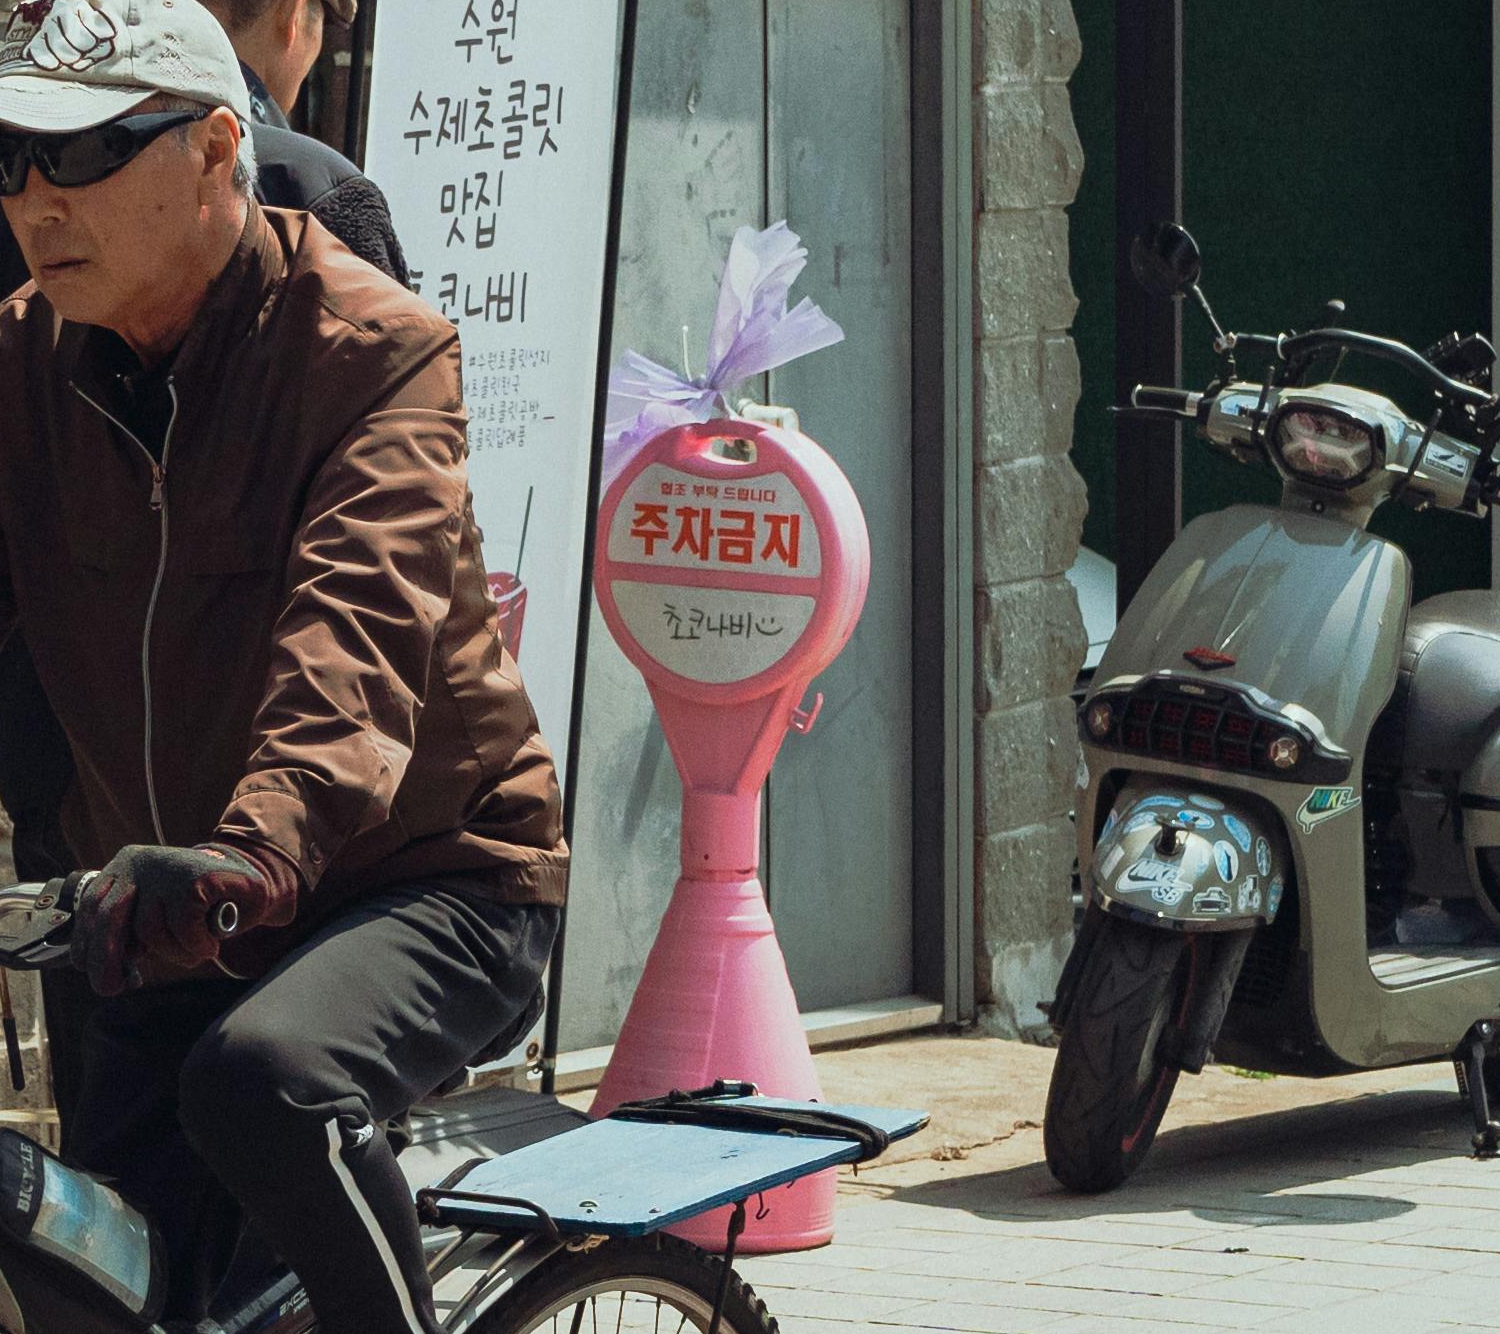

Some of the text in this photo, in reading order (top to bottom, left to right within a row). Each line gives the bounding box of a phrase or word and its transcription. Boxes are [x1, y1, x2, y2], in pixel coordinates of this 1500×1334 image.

[403, 79, 563, 160] 수제초콜릿
[440, 170, 504, 250] 맛집
[630, 503, 801, 569] 주차금지
[662, 603, 752, 640] 초코나비
